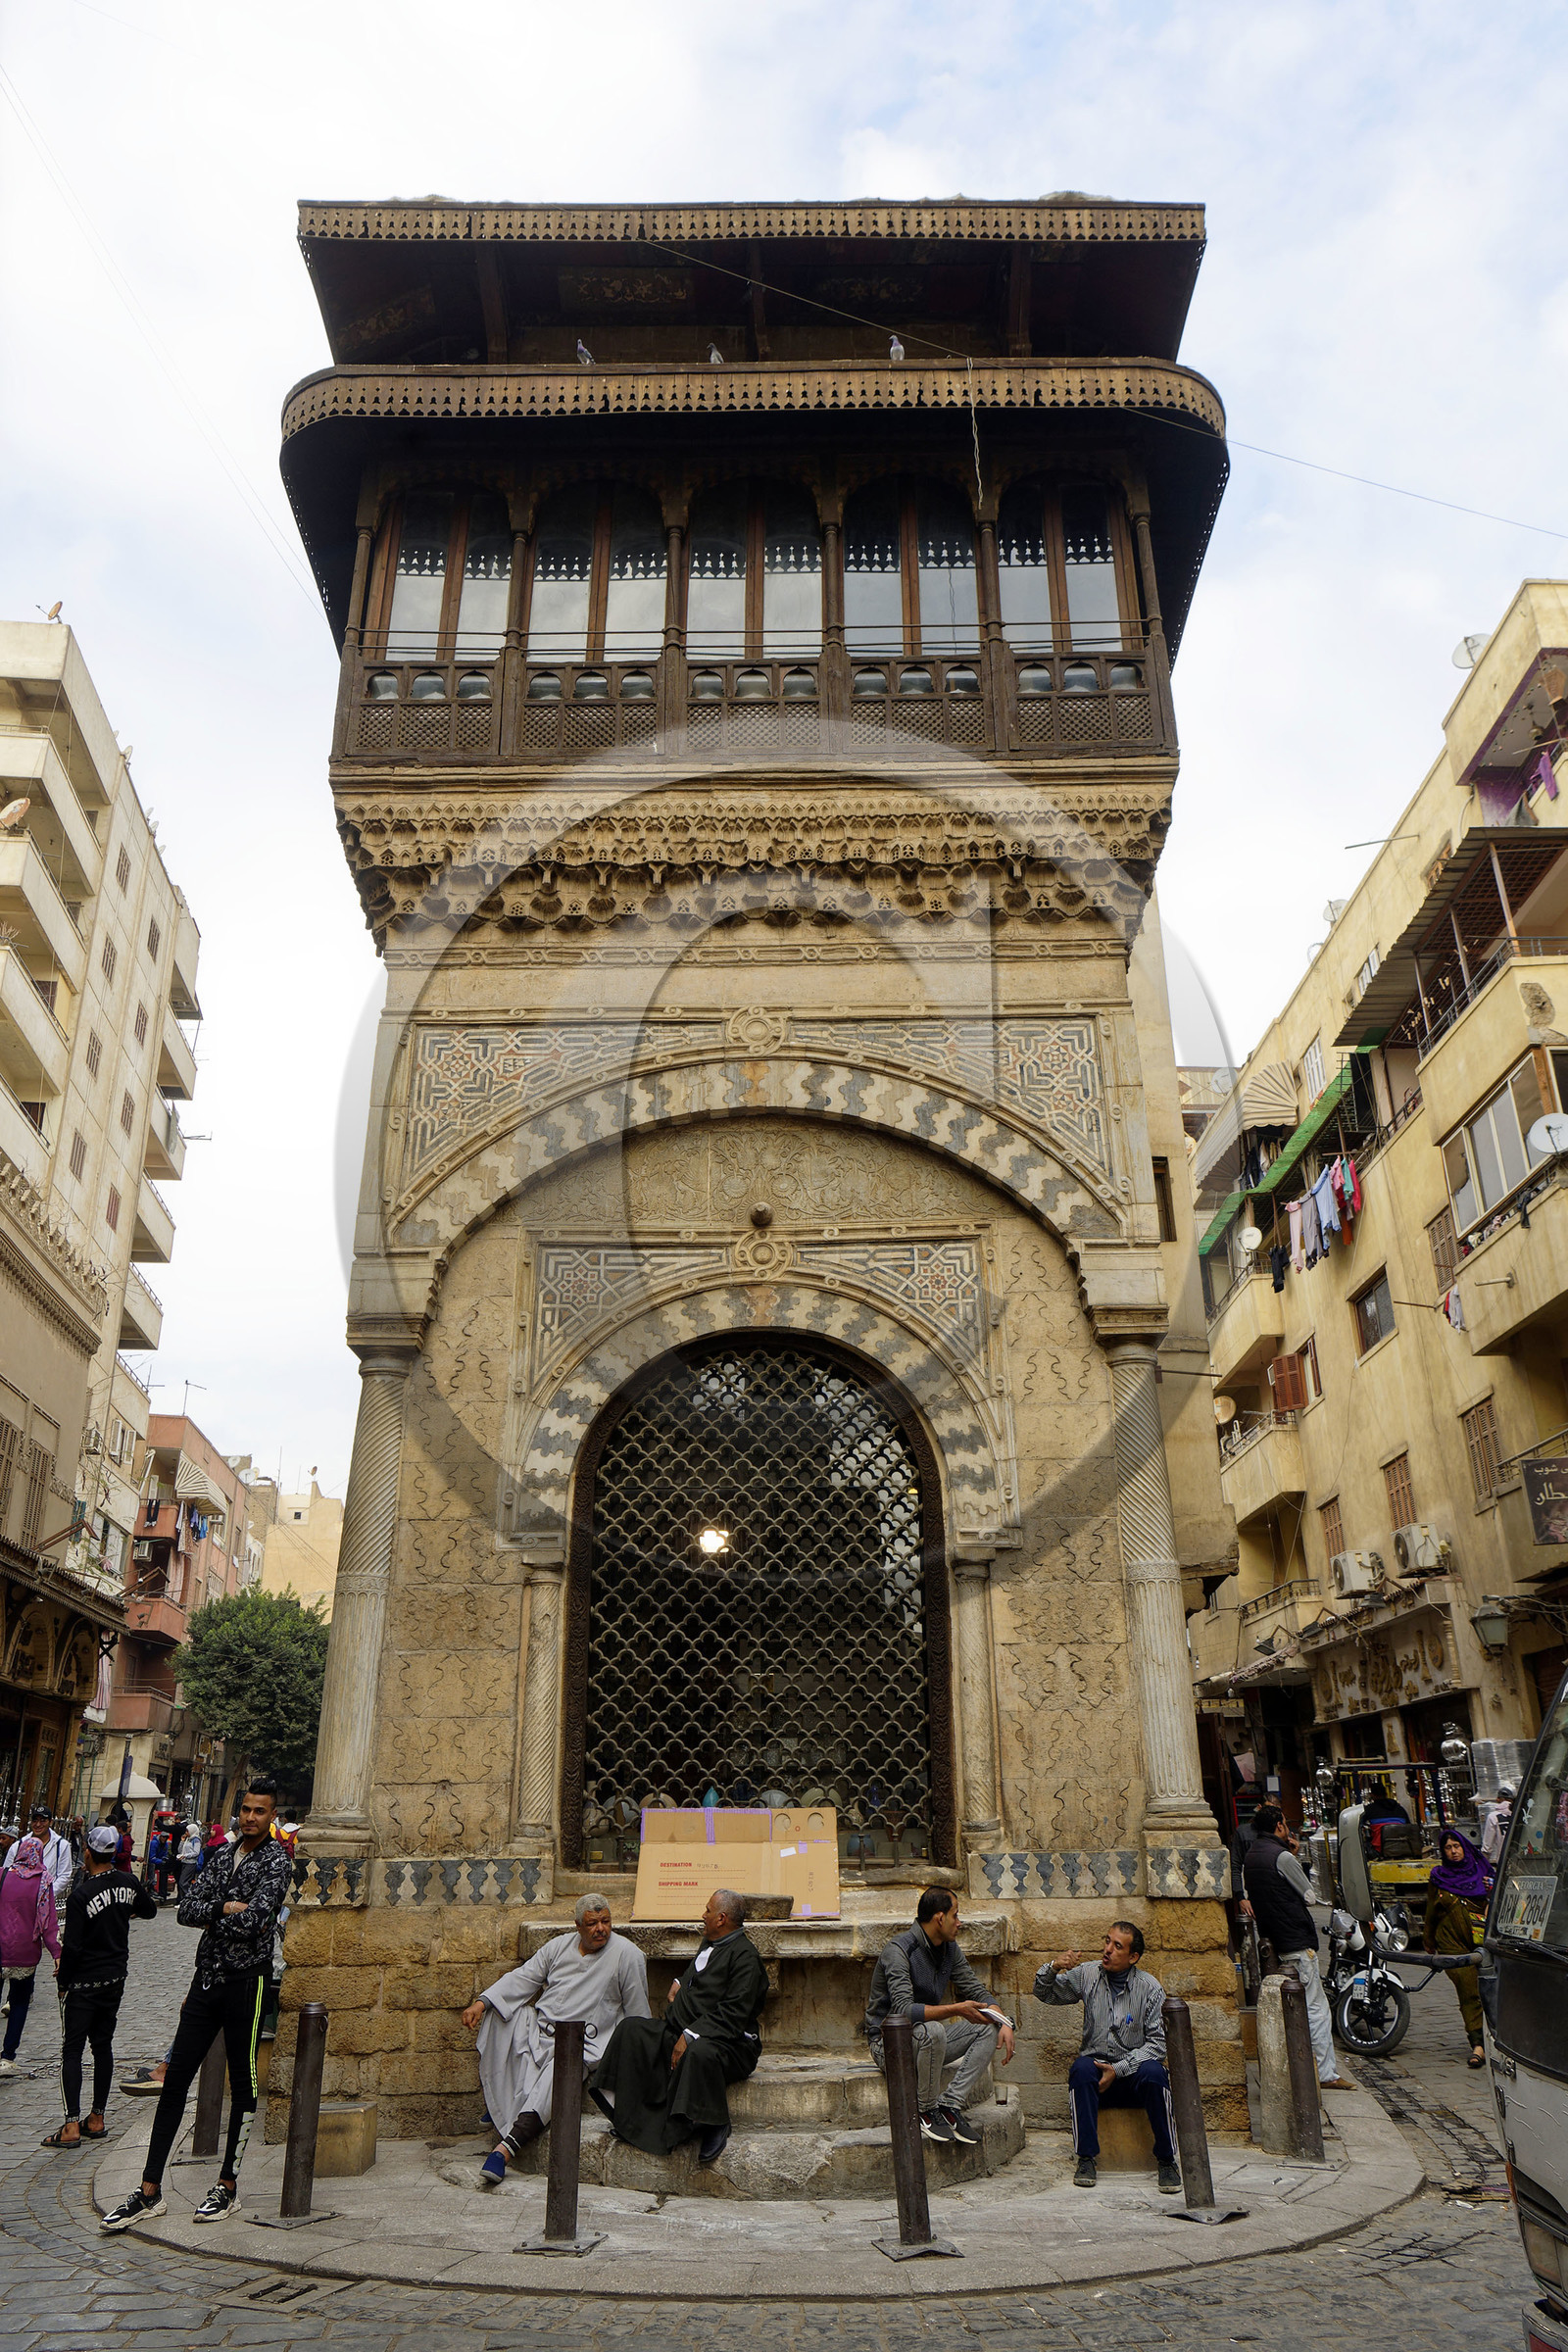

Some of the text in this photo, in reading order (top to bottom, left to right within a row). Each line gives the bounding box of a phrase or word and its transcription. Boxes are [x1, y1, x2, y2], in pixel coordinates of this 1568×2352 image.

[1534, 1464, 1559, 1476] شوب
[86, 1886, 137, 1919] NEW YORK
[1519, 1893, 1550, 1928] 2864
